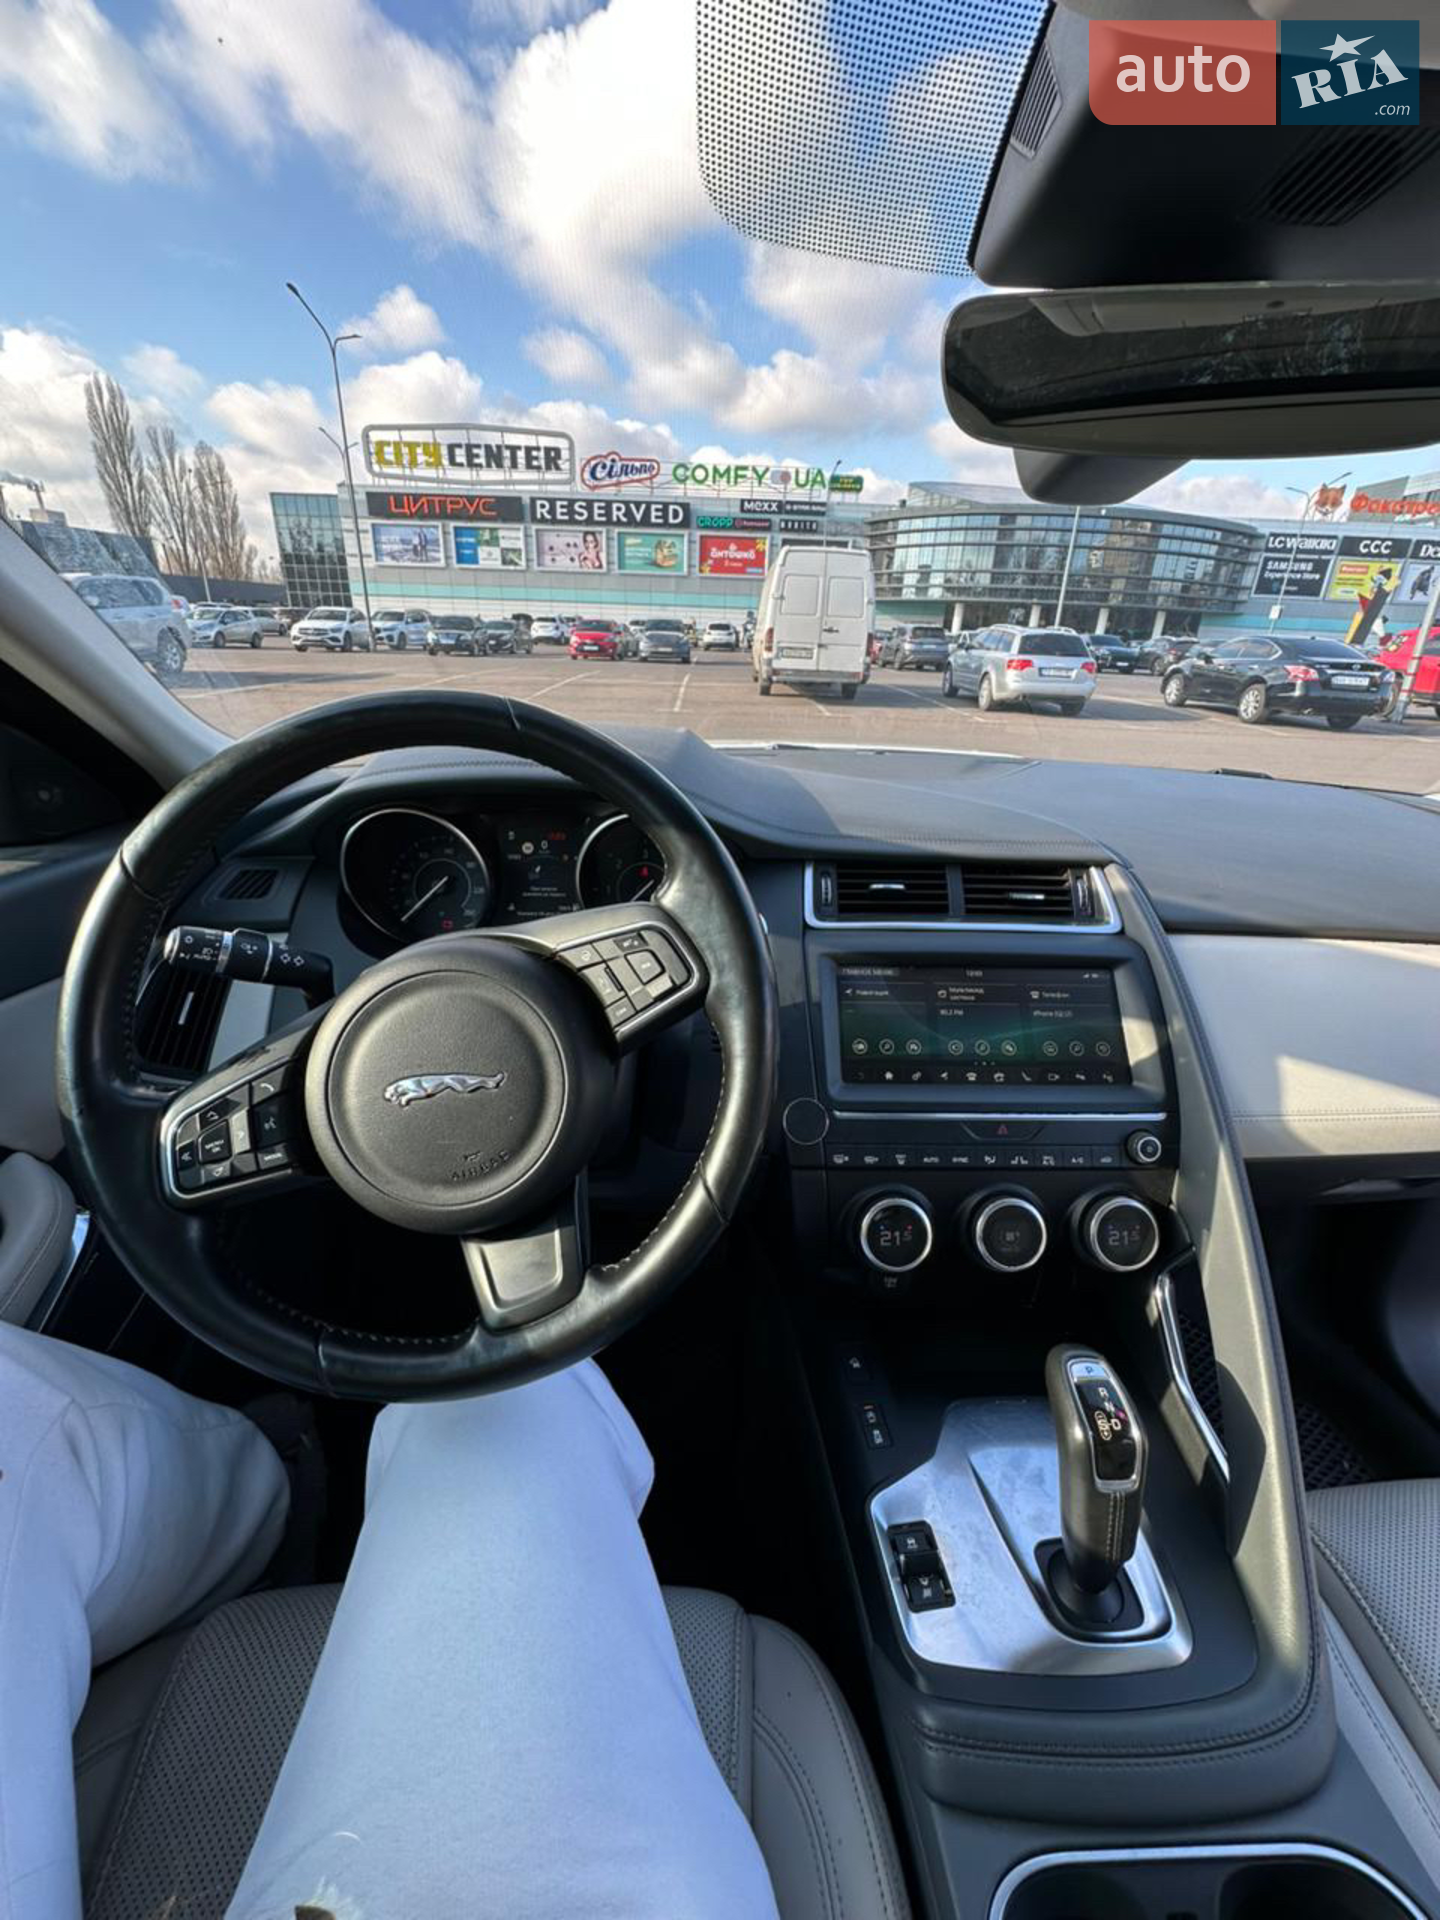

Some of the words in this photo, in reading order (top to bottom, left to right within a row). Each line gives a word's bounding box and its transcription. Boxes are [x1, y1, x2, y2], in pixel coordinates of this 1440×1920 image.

[374, 440, 443, 468] CITY
[447, 443, 563, 471] CENTER
[590, 458, 655, 481] Сільпо
[672, 463, 770, 485] COMFY
[794, 467, 826, 488] UA
[389, 494, 497, 516] ЦИТРУС
[536, 499, 684, 524] RESERVED
[697, 516, 733, 528] CROPP
[1359, 539, 1393, 554] CCC
